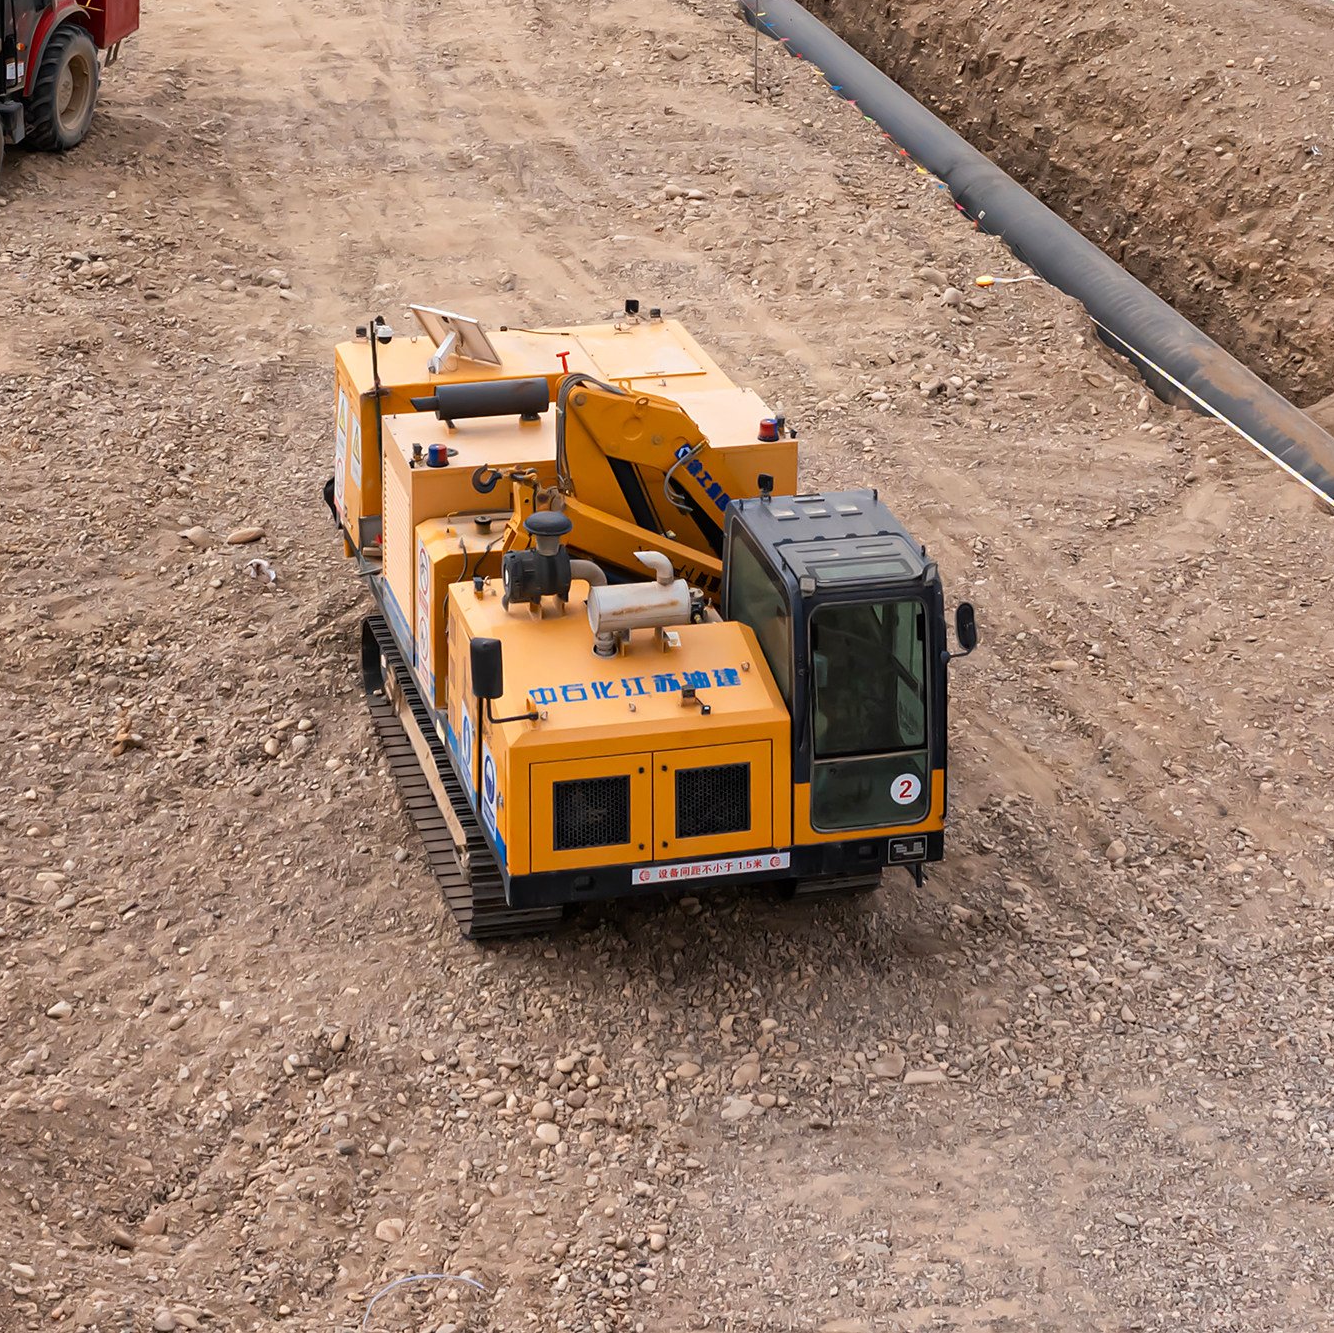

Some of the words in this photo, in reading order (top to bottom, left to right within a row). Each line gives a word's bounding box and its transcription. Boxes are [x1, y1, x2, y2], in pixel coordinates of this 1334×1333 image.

[529, 668, 742, 705] 中石化江苏油建
[899, 780, 913, 799] 2
